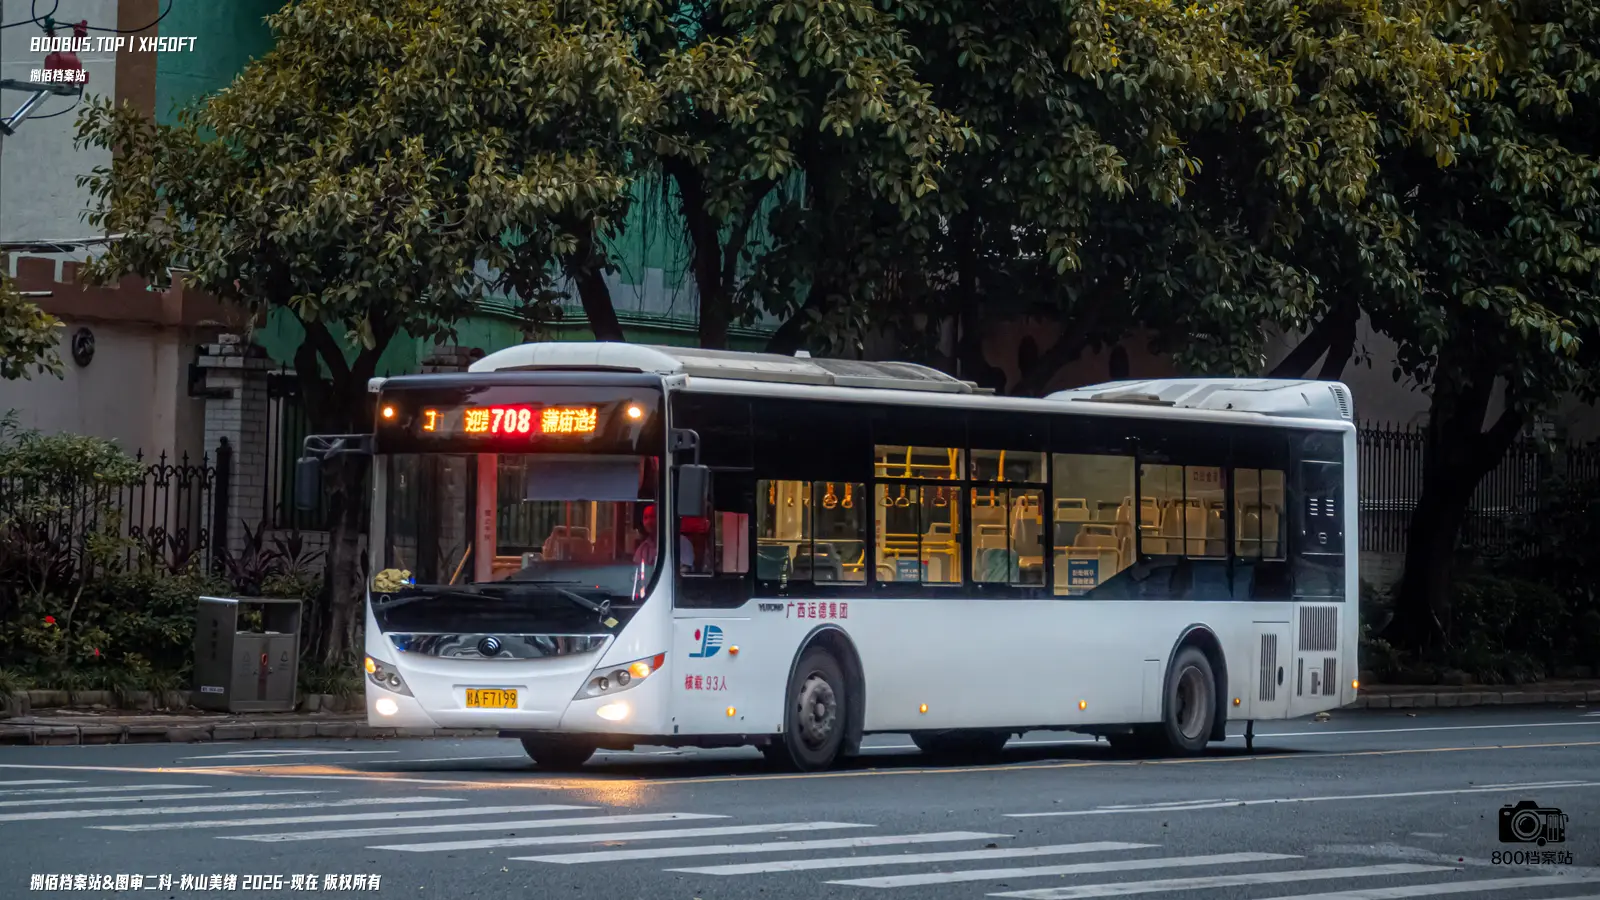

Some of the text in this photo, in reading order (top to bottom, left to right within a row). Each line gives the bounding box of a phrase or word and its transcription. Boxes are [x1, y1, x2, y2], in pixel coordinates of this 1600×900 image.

[491, 408, 531, 433] 708
[786, 602, 848, 619] 广西运德集团
